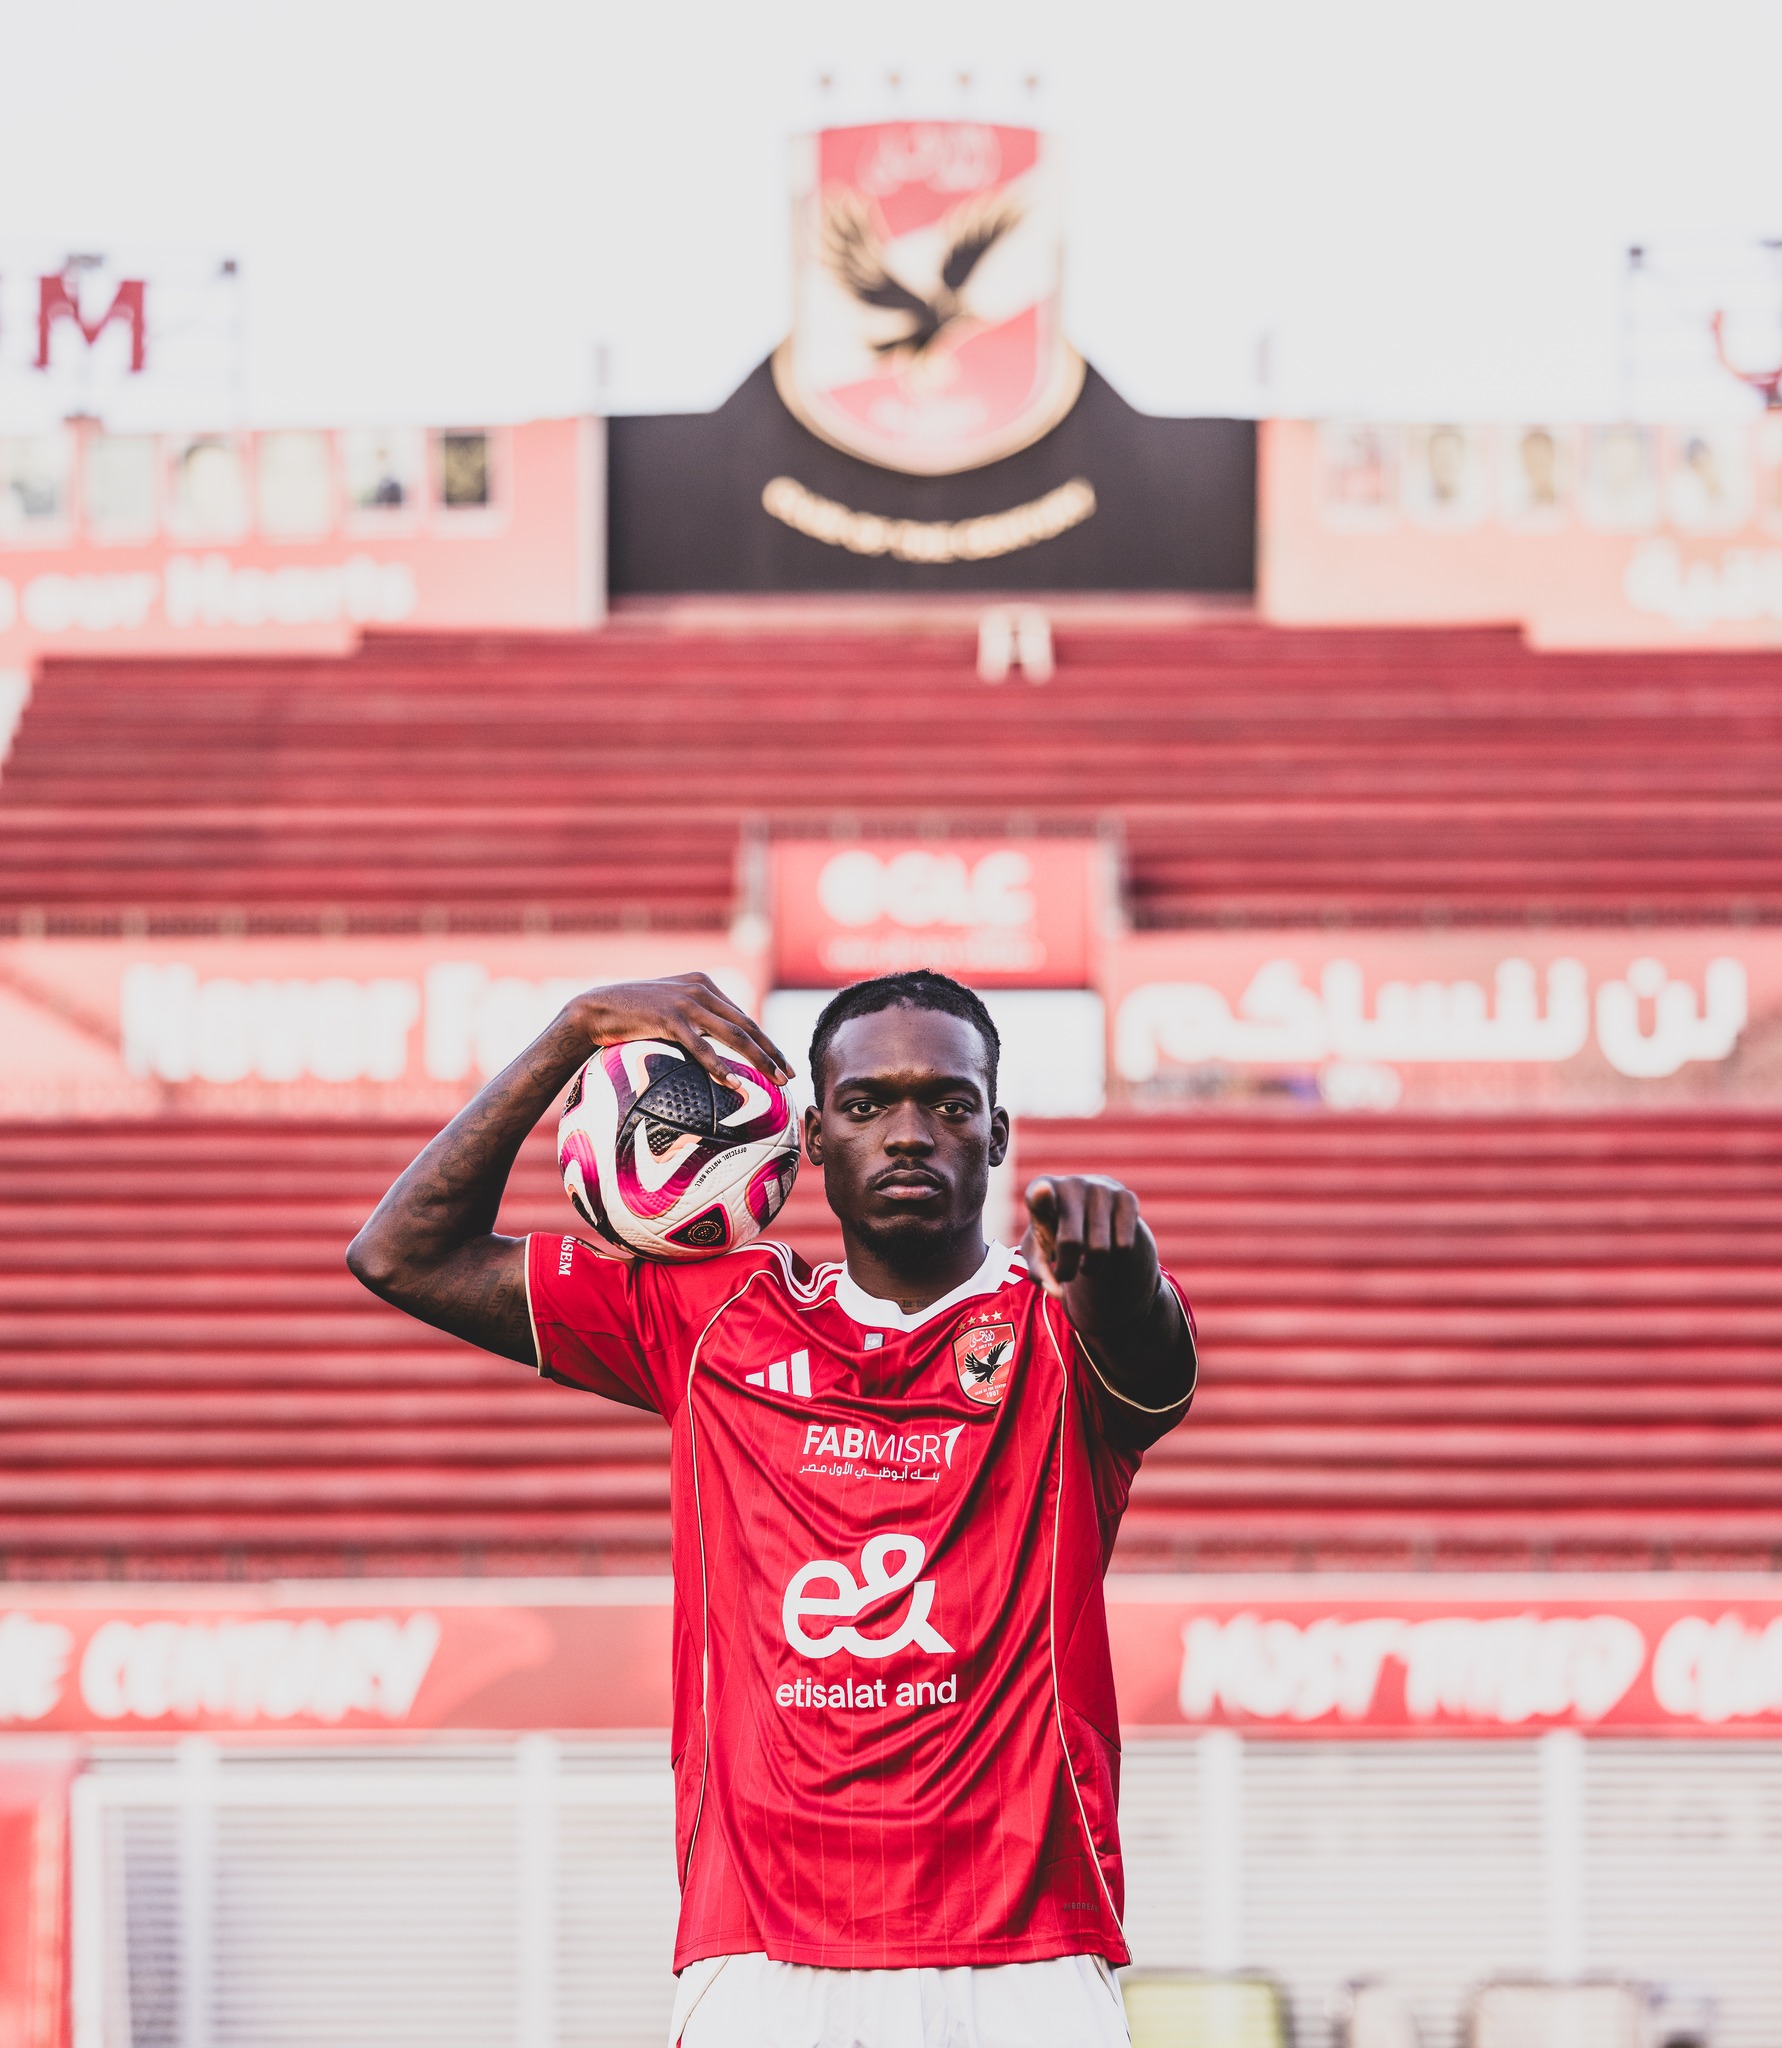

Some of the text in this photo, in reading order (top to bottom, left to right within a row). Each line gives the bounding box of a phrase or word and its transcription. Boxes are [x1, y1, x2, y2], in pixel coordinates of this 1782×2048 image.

[0, 273, 146, 373] M
[802, 1425, 941, 1464] FABMISR
[799, 1461, 940, 1483] بنك أبوظبي الأول مصر
[776, 1674, 957, 1708] etisalat and
